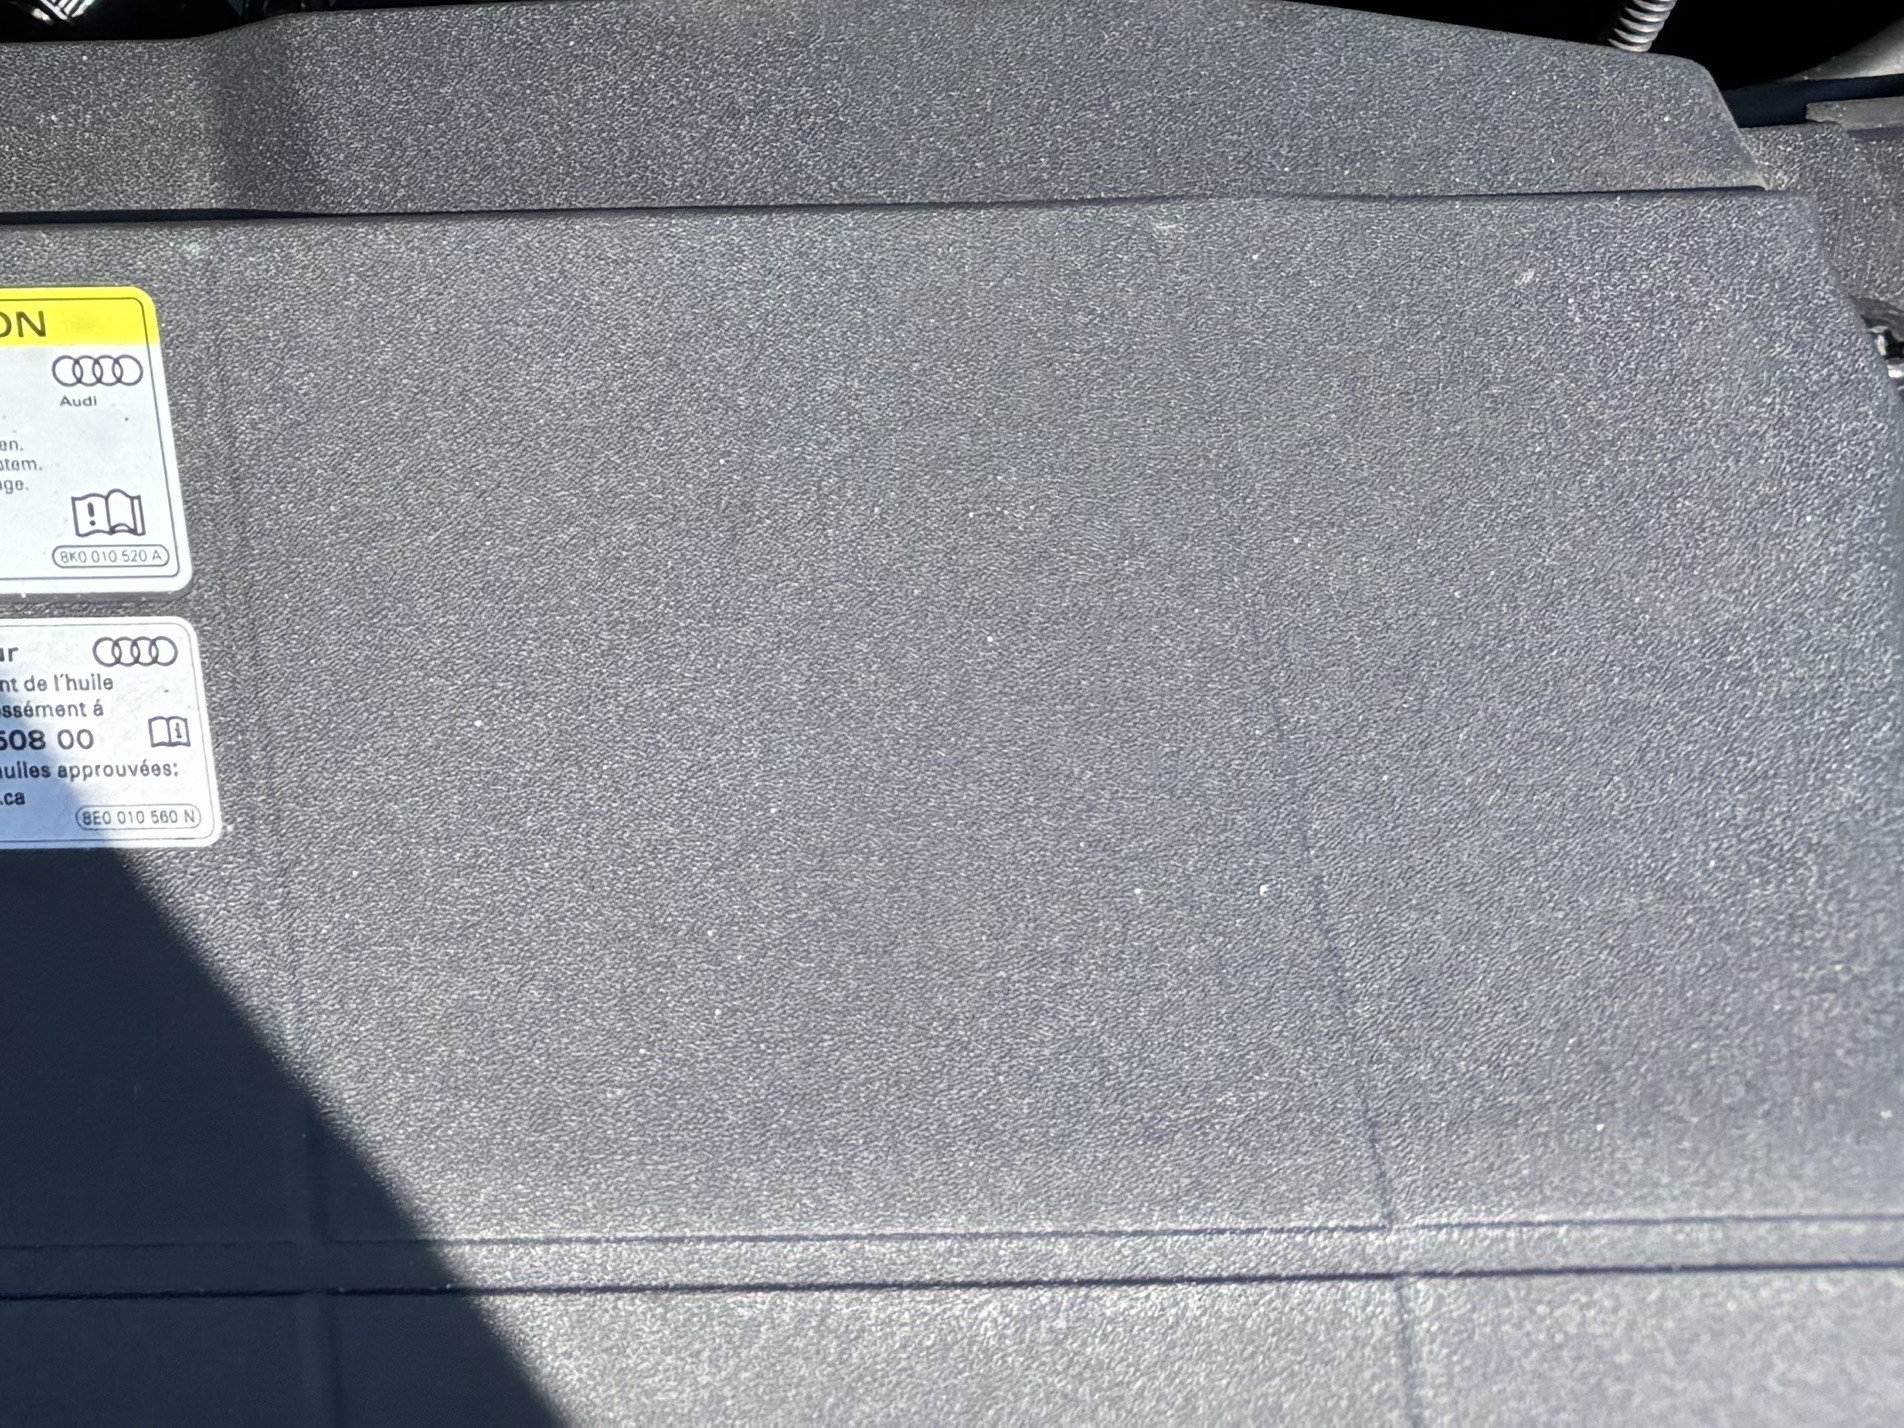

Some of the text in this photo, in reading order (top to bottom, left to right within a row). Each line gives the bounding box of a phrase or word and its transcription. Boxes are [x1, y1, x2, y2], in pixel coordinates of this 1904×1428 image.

[59, 394, 98, 407] Audi
[91, 549, 117, 564] 010
[121, 548, 147, 563] 520
[151, 547, 164, 562] A
[24, 675, 46, 691] de
[57, 728, 93, 749] 00
[57, 760, 177, 782] approuvées:
[117, 810, 144, 824] 010
[150, 809, 177, 824] 560
[184, 809, 196, 825] N
